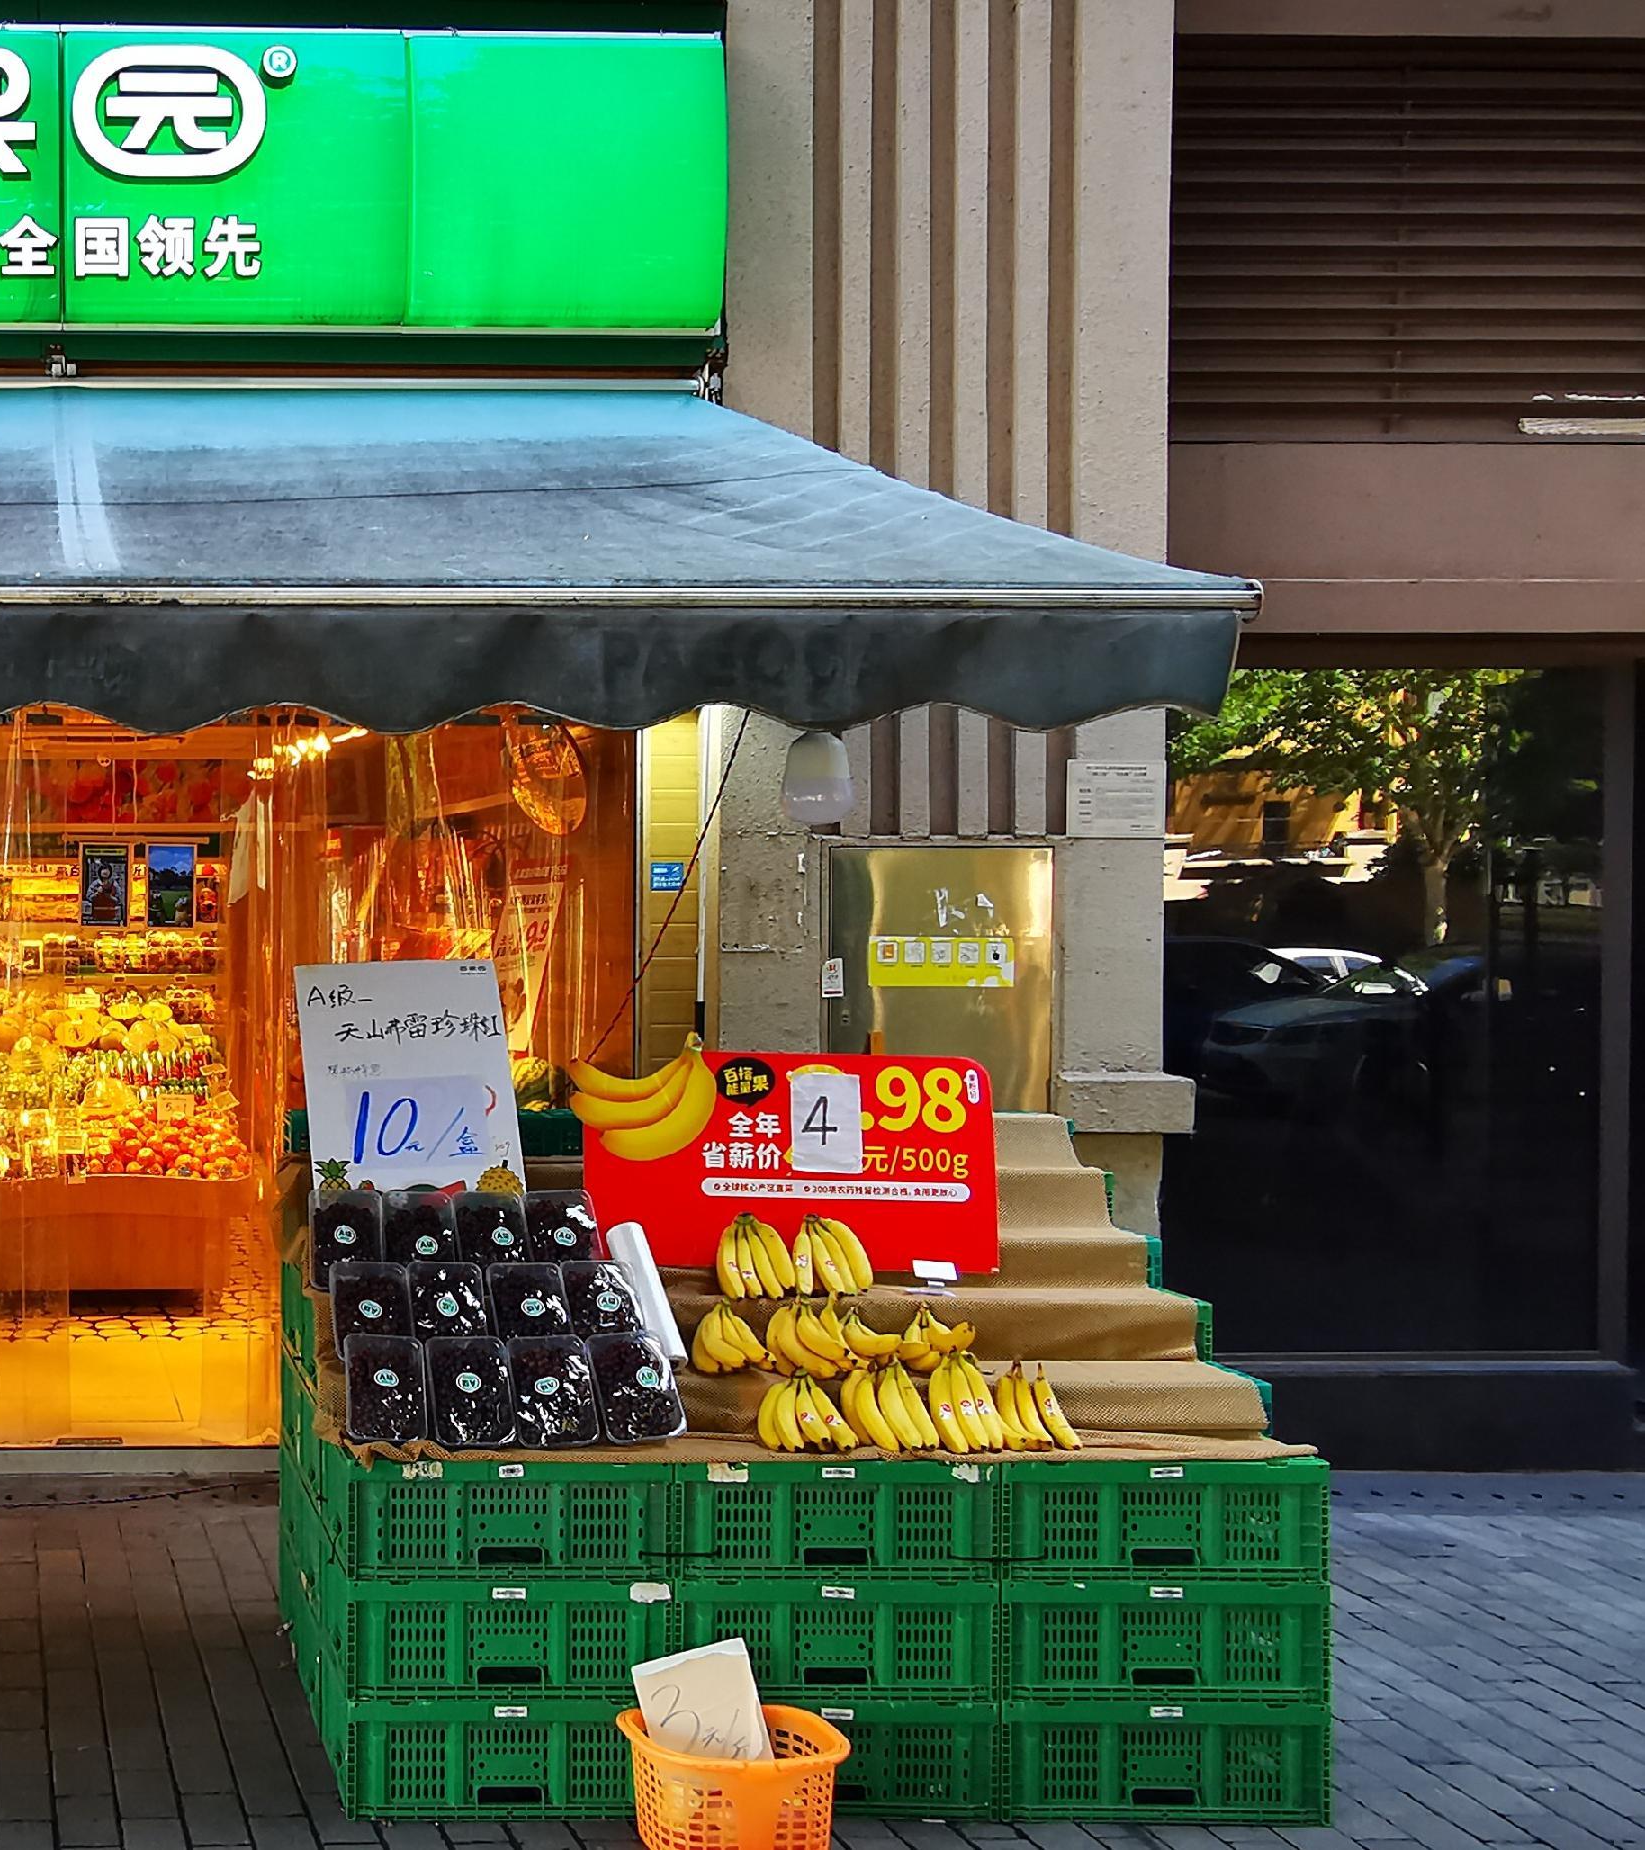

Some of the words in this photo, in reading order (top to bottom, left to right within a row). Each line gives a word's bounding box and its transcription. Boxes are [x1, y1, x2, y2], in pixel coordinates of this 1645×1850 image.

[728, 1111, 782, 1139] 全年
[702, 1142, 781, 1171] 省薪价
